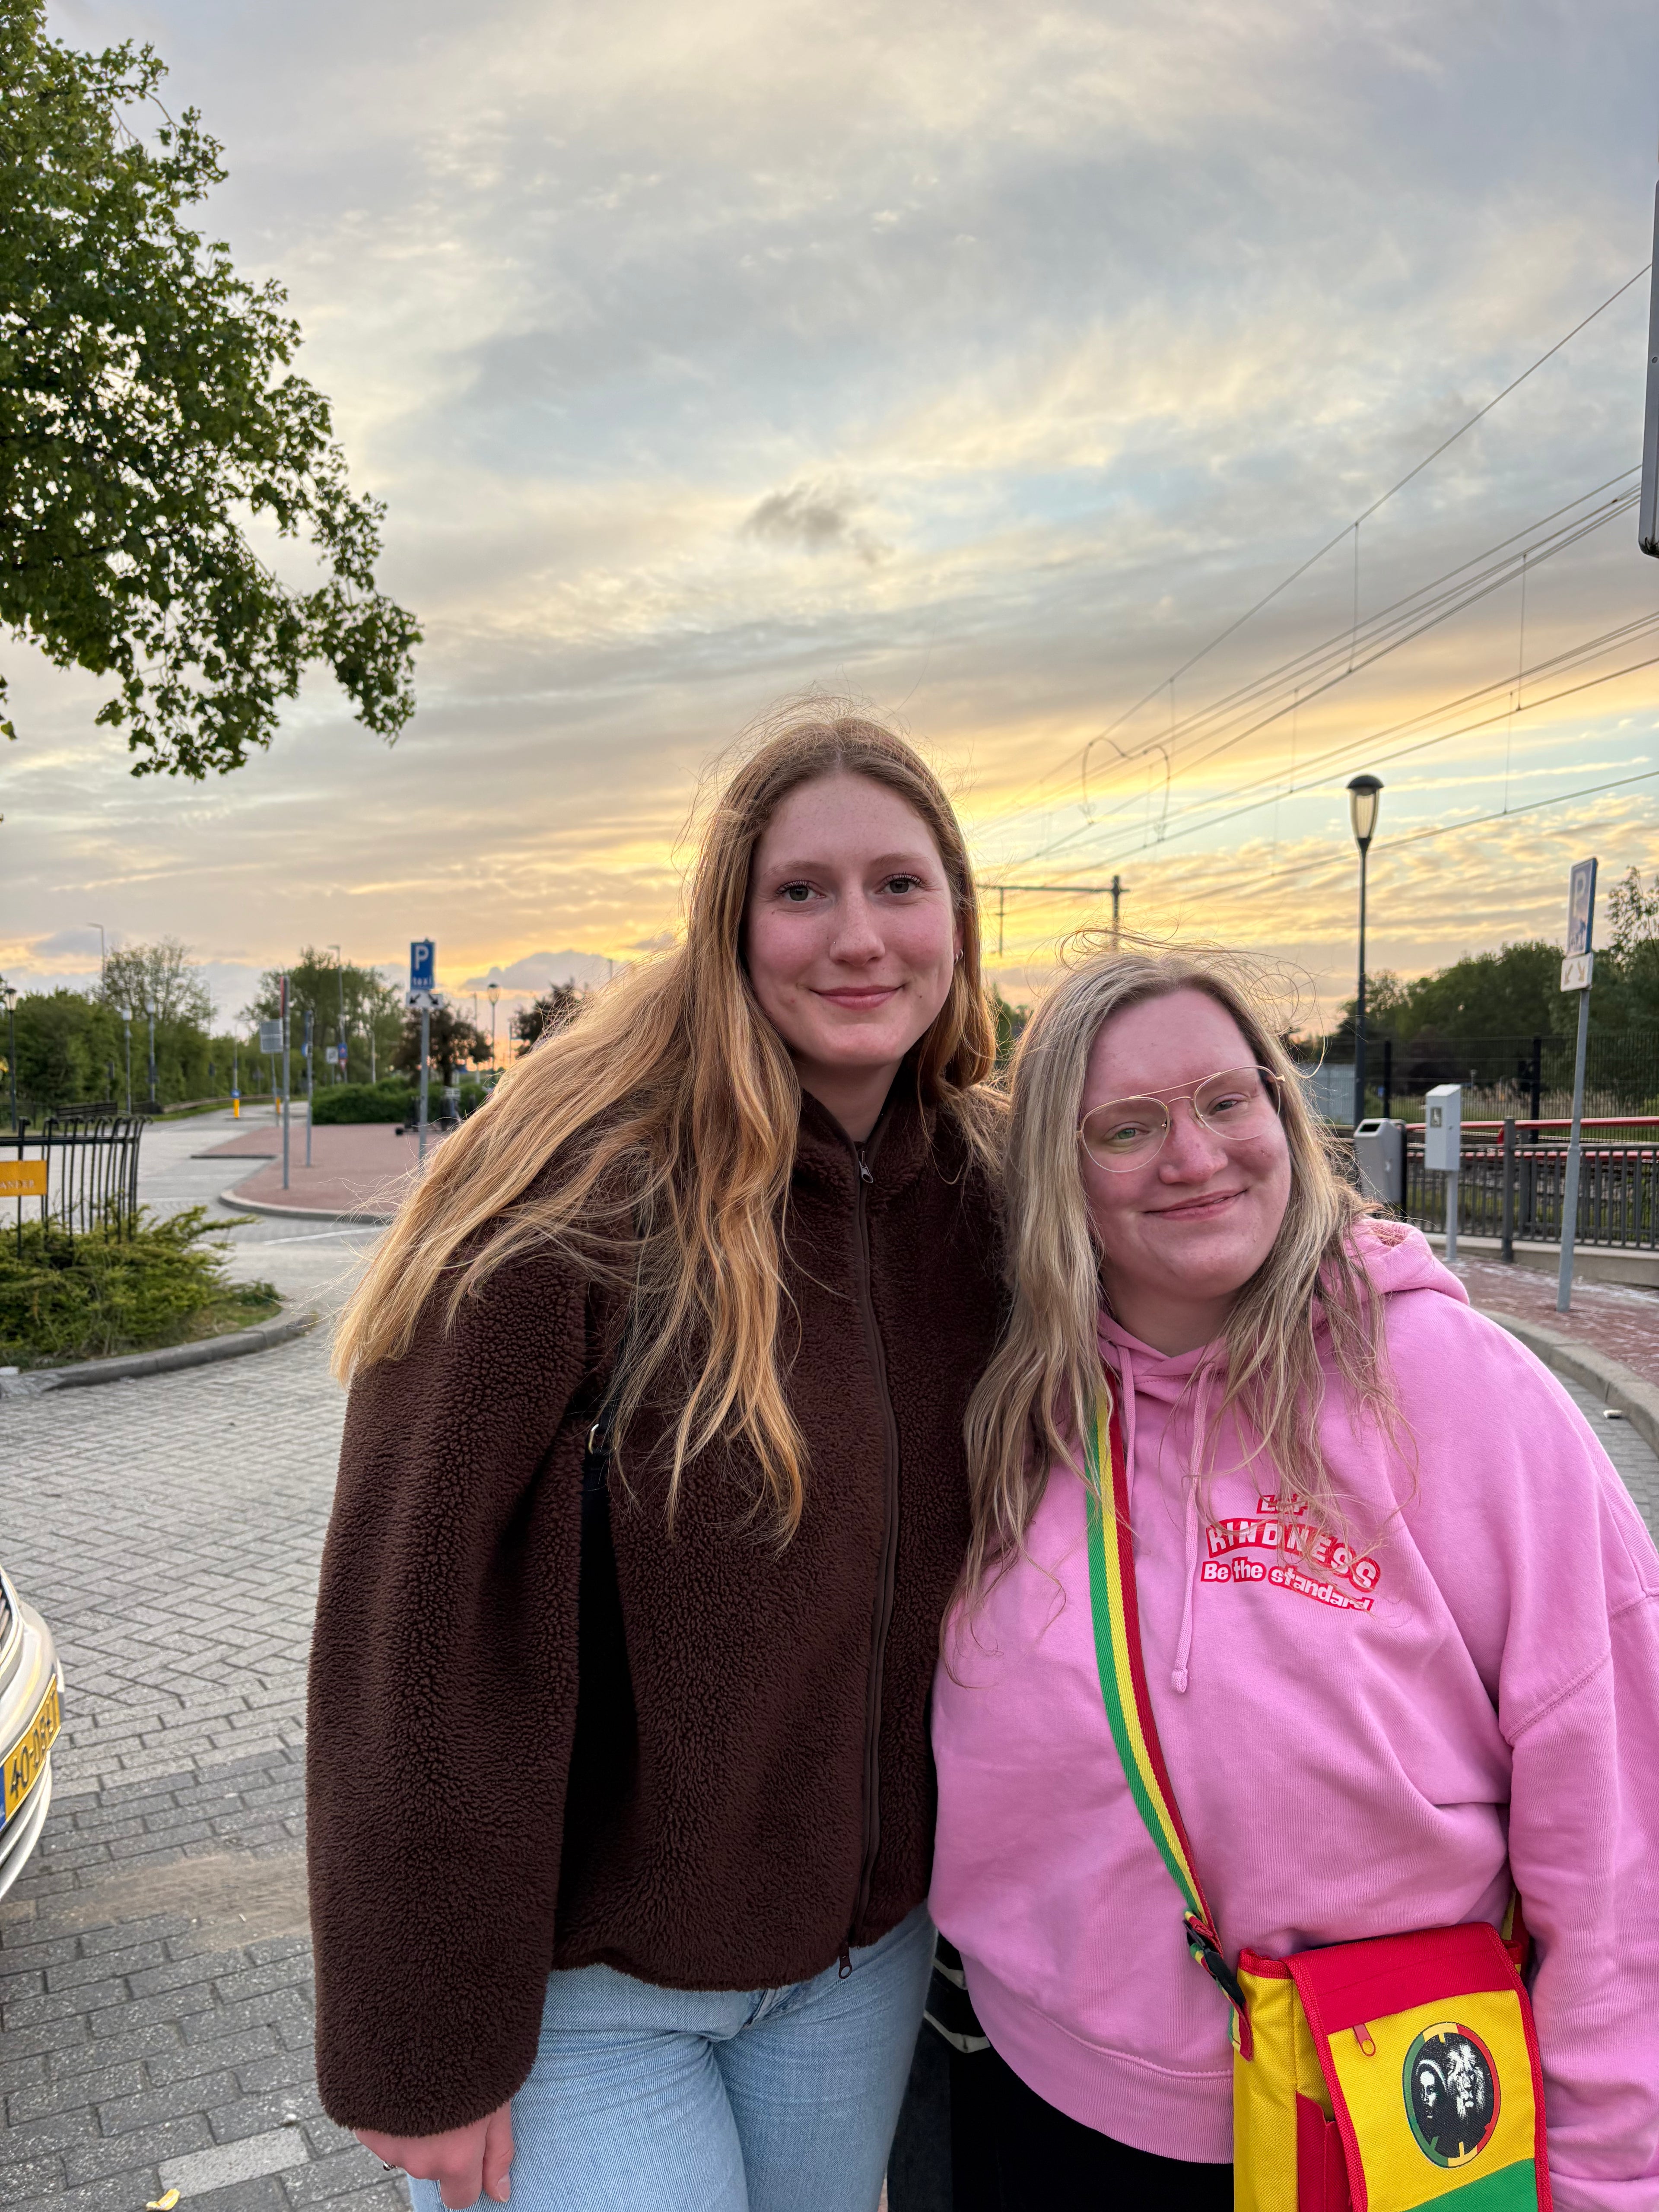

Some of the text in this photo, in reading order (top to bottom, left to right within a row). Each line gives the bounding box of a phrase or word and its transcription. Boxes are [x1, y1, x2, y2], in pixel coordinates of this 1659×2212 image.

[415, 945, 429, 970] P
[413, 977, 432, 985] taxi
[1261, 1495, 1307, 1513] Lt
[1208, 1521, 1376, 1589] KINDNESS
[1204, 1557, 1370, 1611] Be the standard
